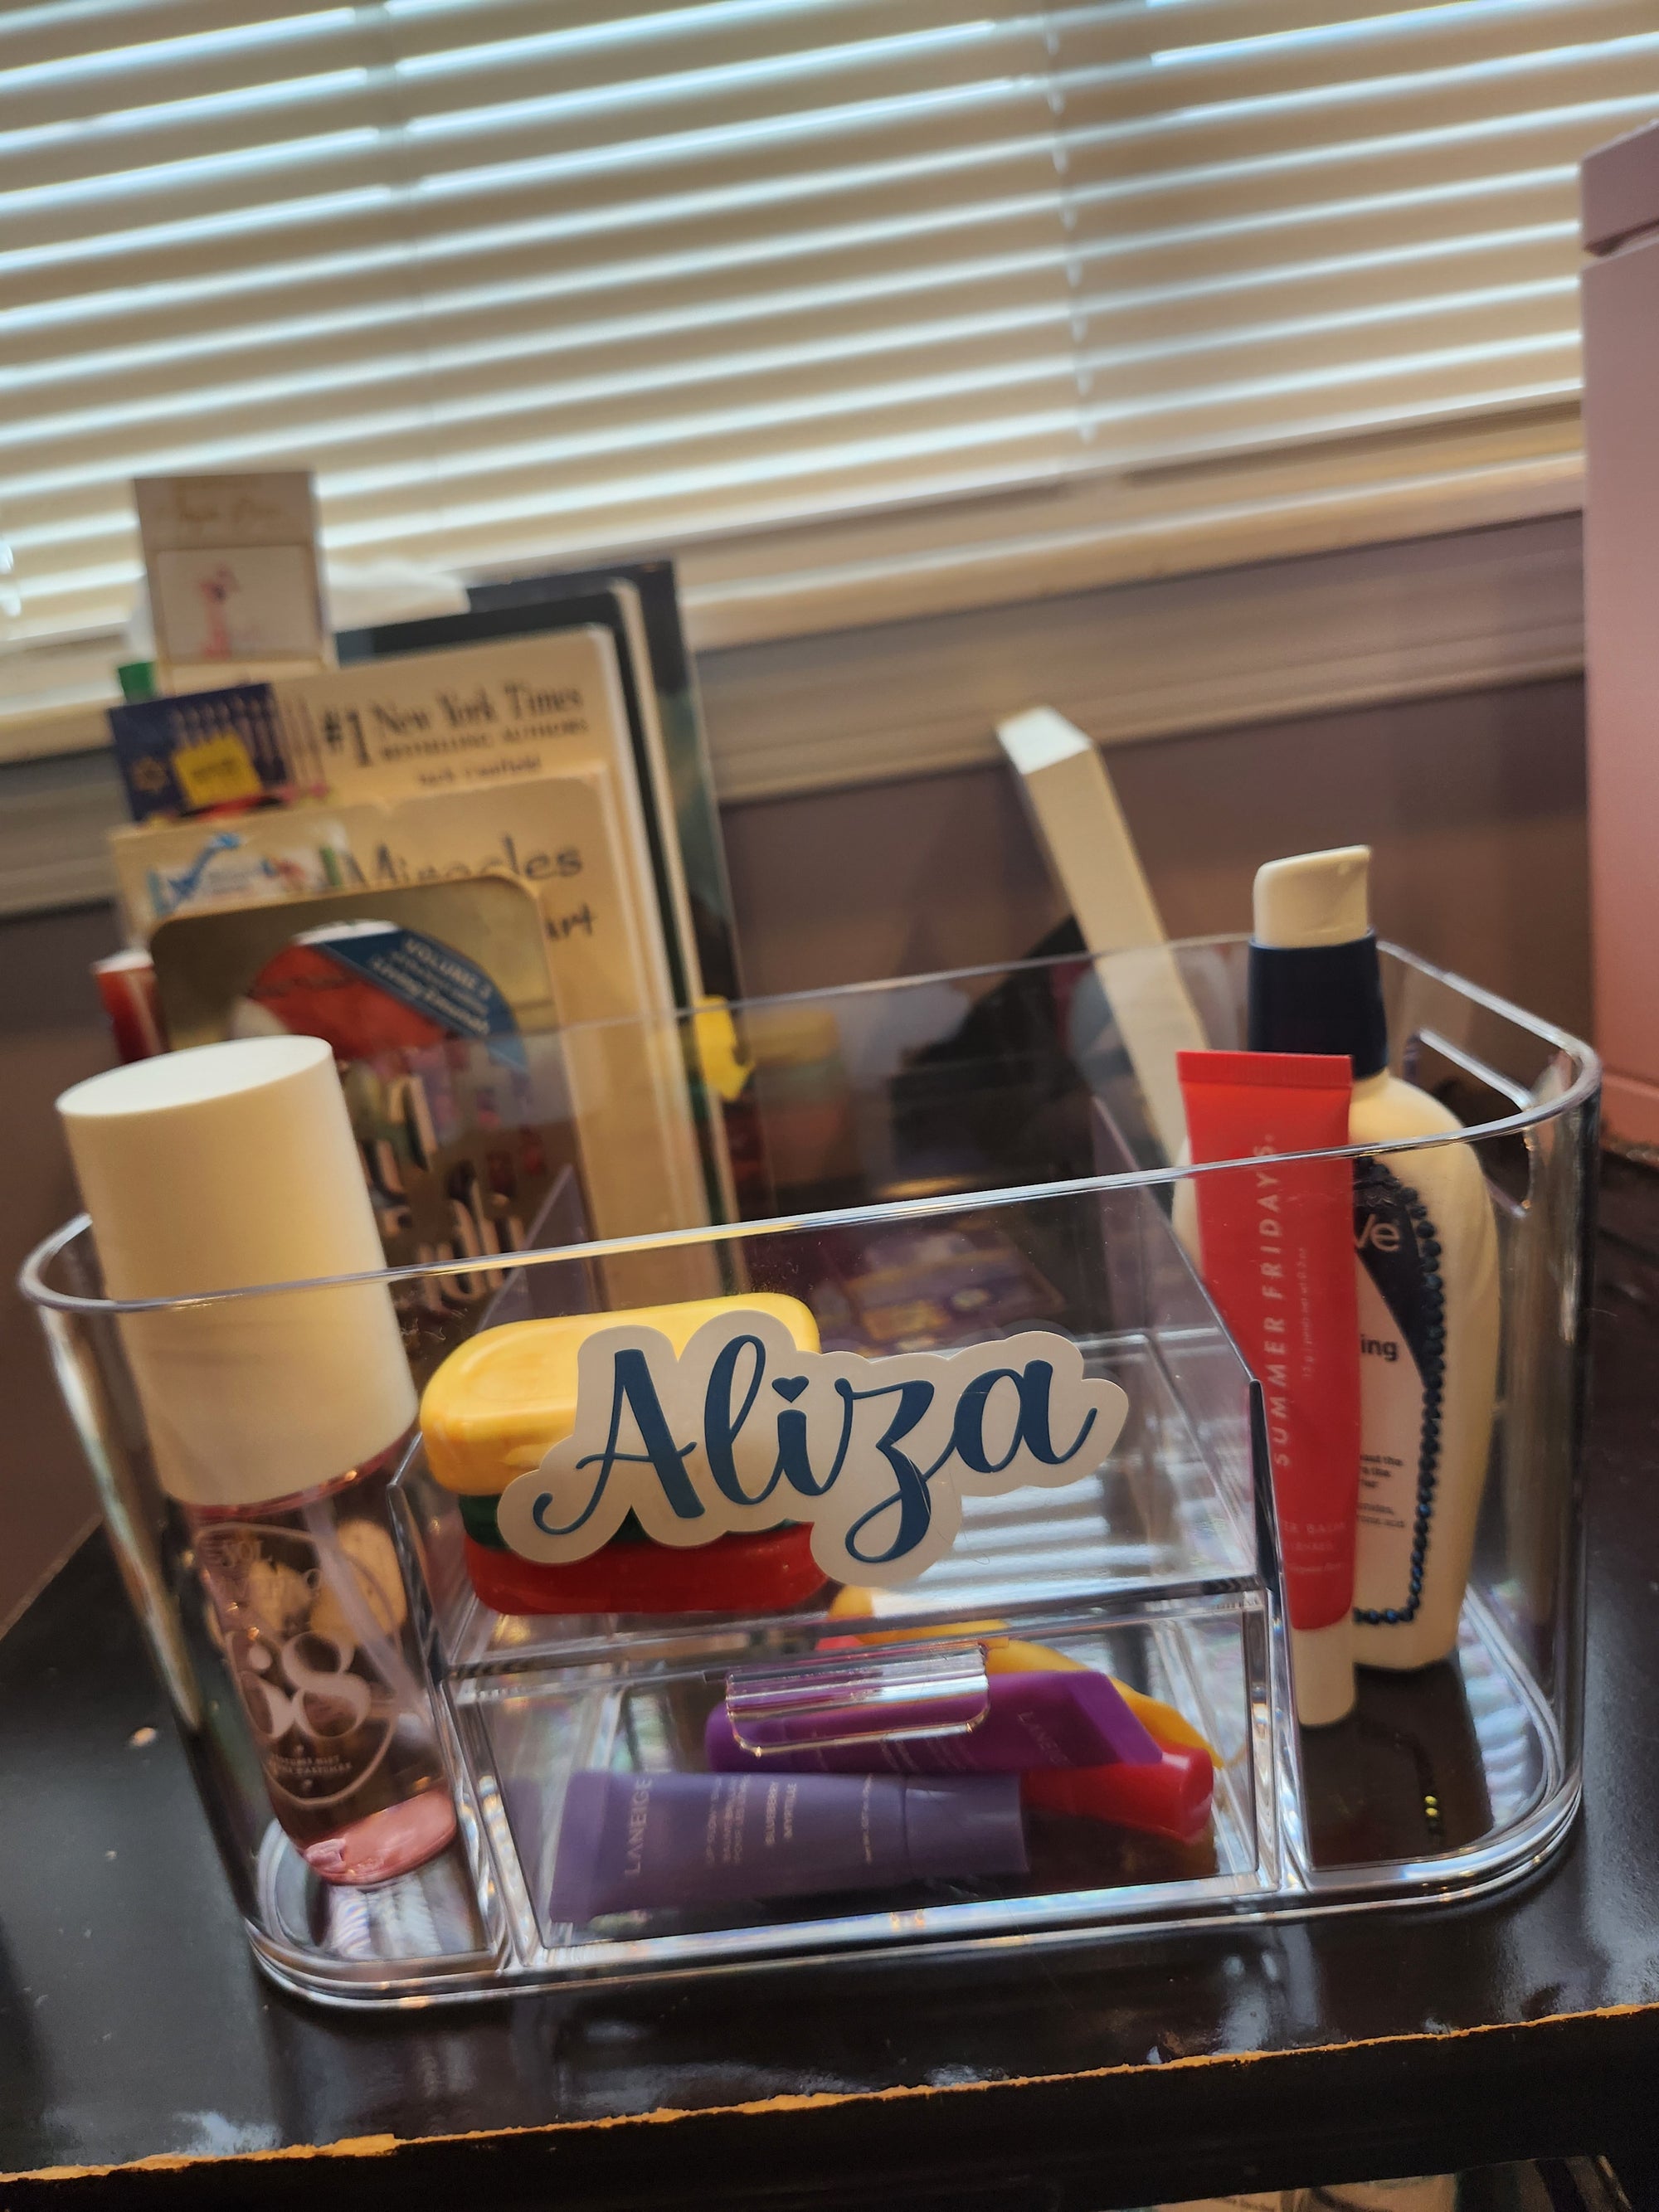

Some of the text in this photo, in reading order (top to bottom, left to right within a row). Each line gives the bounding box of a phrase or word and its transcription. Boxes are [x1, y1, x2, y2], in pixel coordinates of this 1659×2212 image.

[324, 679, 583, 768] #1 New York Times
[532, 1334, 1098, 1563] Aliza
[1262, 1315, 1292, 1468] SUMMER
[624, 1778, 653, 1877] LANEIGE
